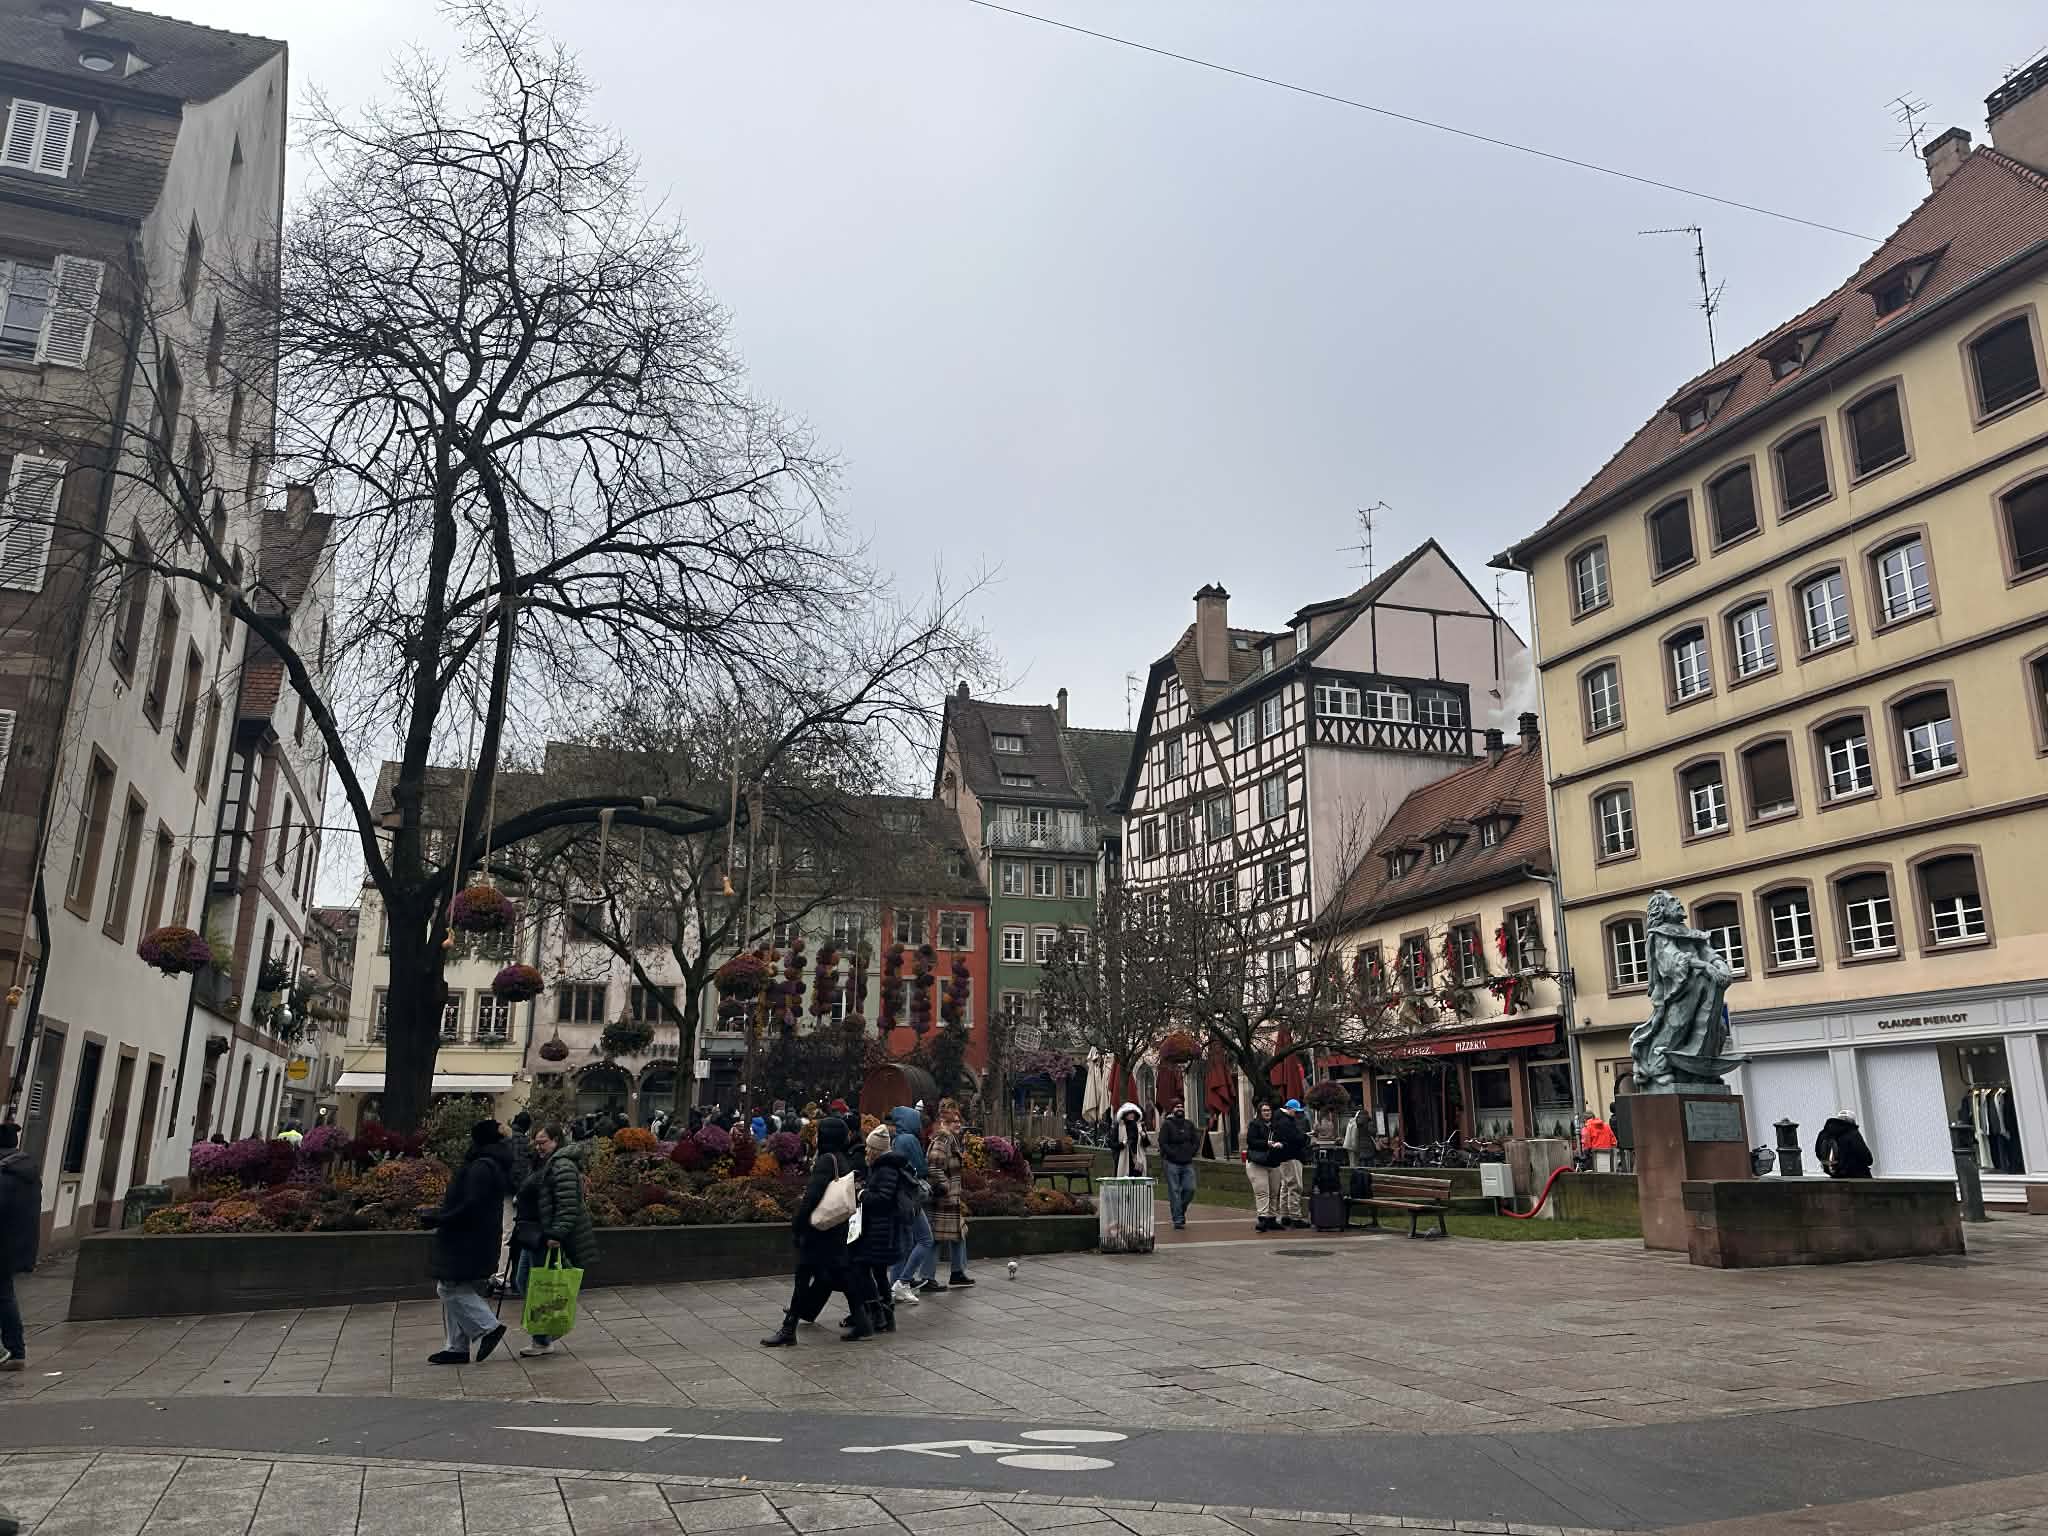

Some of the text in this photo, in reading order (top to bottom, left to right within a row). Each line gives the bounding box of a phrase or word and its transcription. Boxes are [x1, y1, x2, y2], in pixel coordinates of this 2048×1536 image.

[1878, 1013, 1968, 1029] CLAUDIE PIERLOT
[1455, 1040, 1487, 1052] PIZZERIA
